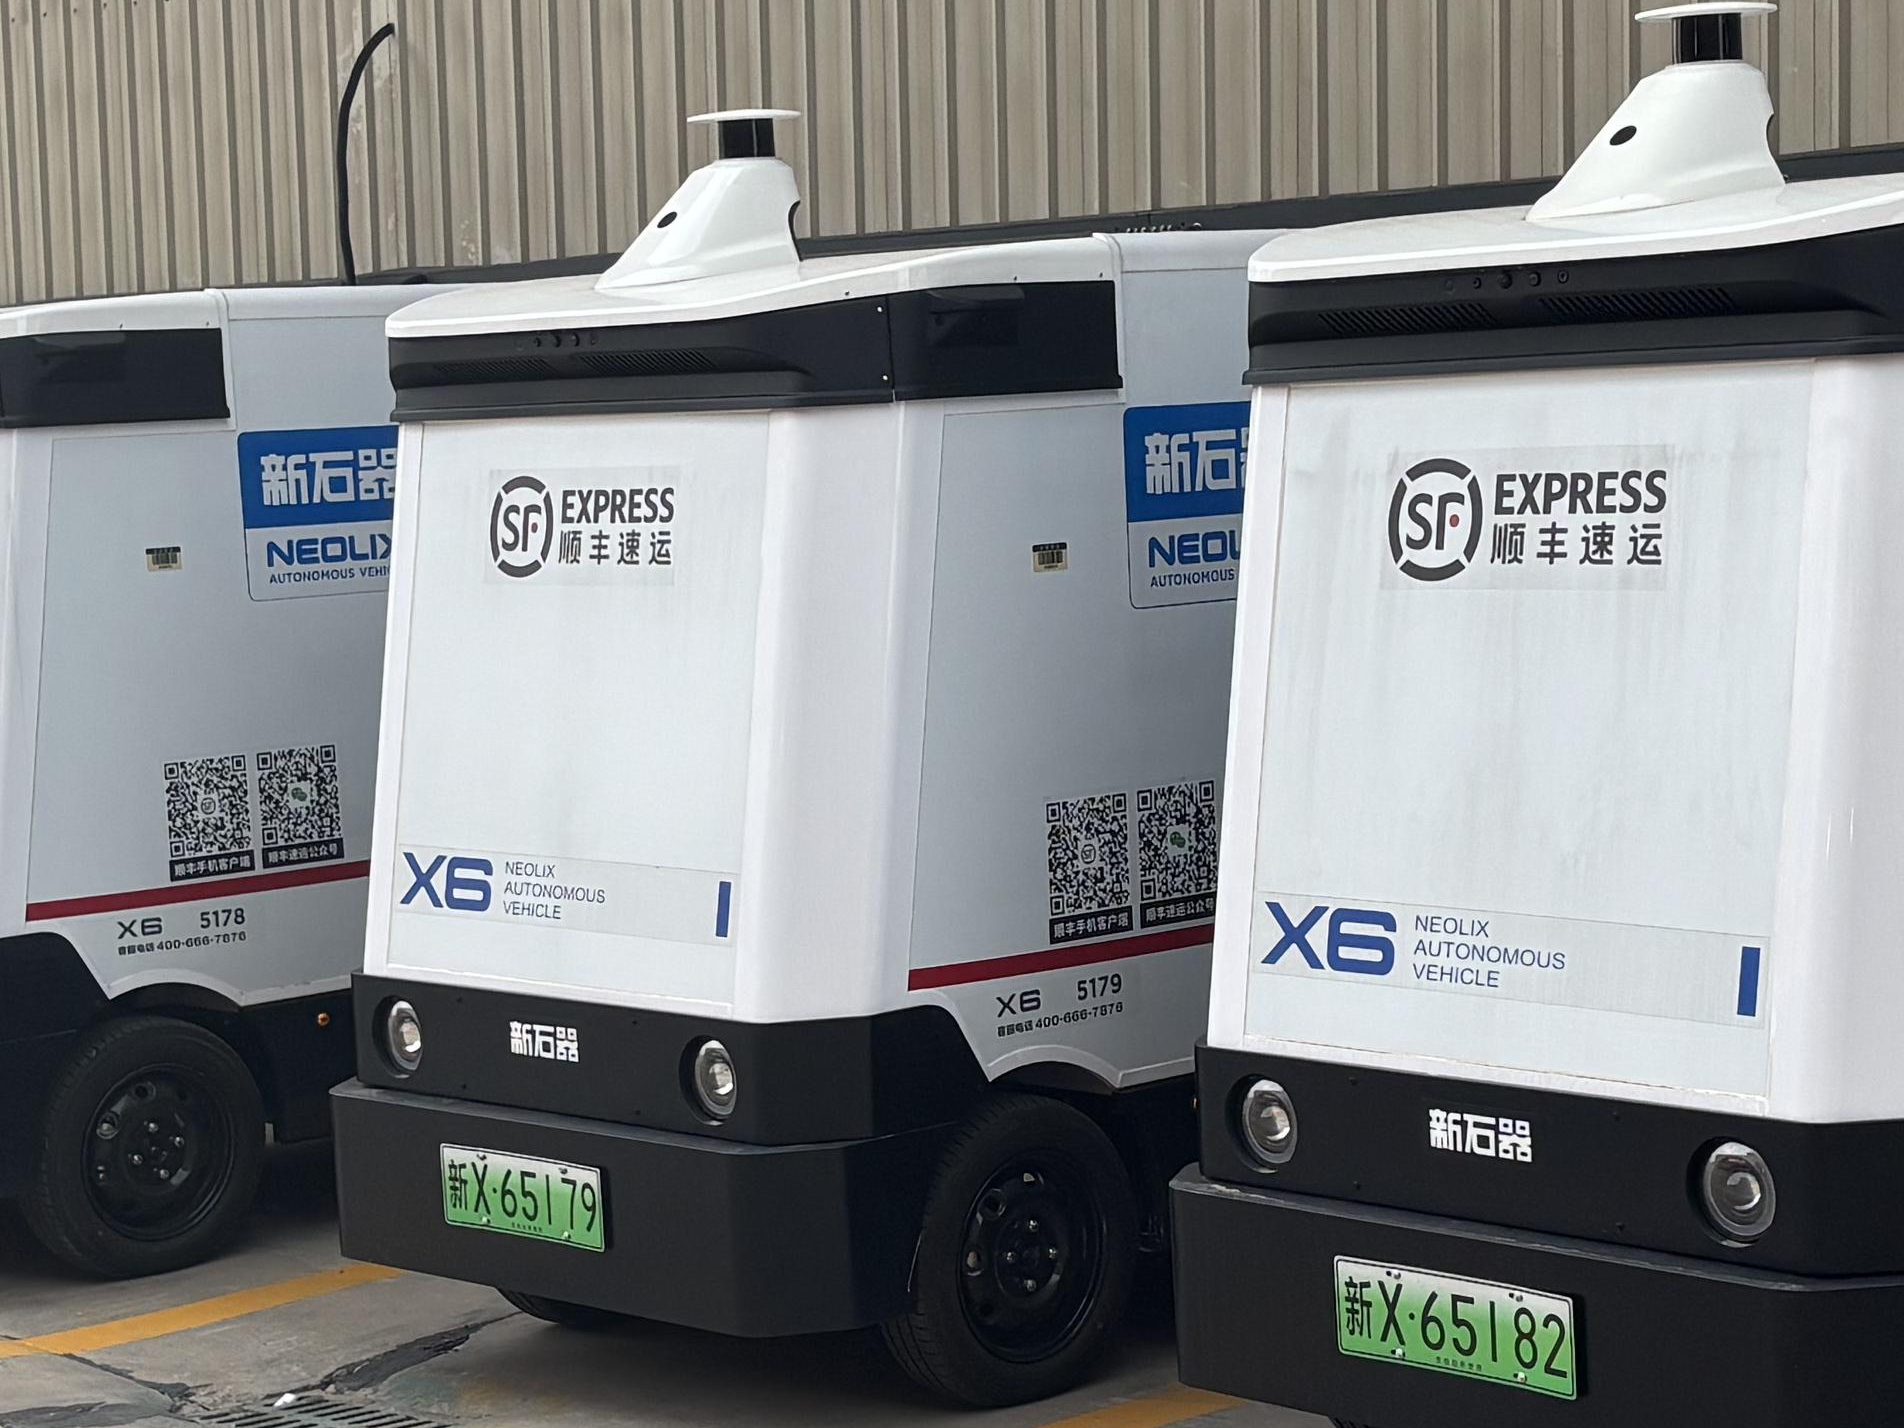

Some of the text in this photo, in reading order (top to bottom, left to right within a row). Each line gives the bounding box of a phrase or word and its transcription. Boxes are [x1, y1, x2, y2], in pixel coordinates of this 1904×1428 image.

[260, 447, 397, 506] 新石器
[1144, 427, 1249, 495] 新石
[561, 487, 675, 524] EXPRESS
[1494, 469, 1667, 515] EXPRESS
[558, 529, 672, 565] 顺丰速运
[1490, 521, 1663, 565] 顺丰速运
[269, 568, 354, 584] AUTONOMOUS
[1150, 568, 1235, 588] AUTONOMOUS
[400, 852, 494, 912] X6
[505, 861, 556, 879] NEOLIX
[503, 900, 562, 920] VEHICLE
[504, 881, 606, 904] AUTONOMOUS
[117, 907, 246, 940] X6 5178
[1261, 901, 1397, 976] X6
[1415, 914, 1490, 938] NEOLIX
[1413, 938, 1566, 971] AUTONOMOUS
[1412, 963, 1501, 988] VEHICLE
[996, 973, 1123, 1018] X6 5179
[509, 1020, 580, 1063] 新石器
[1428, 1108, 1533, 1163] 新石器
